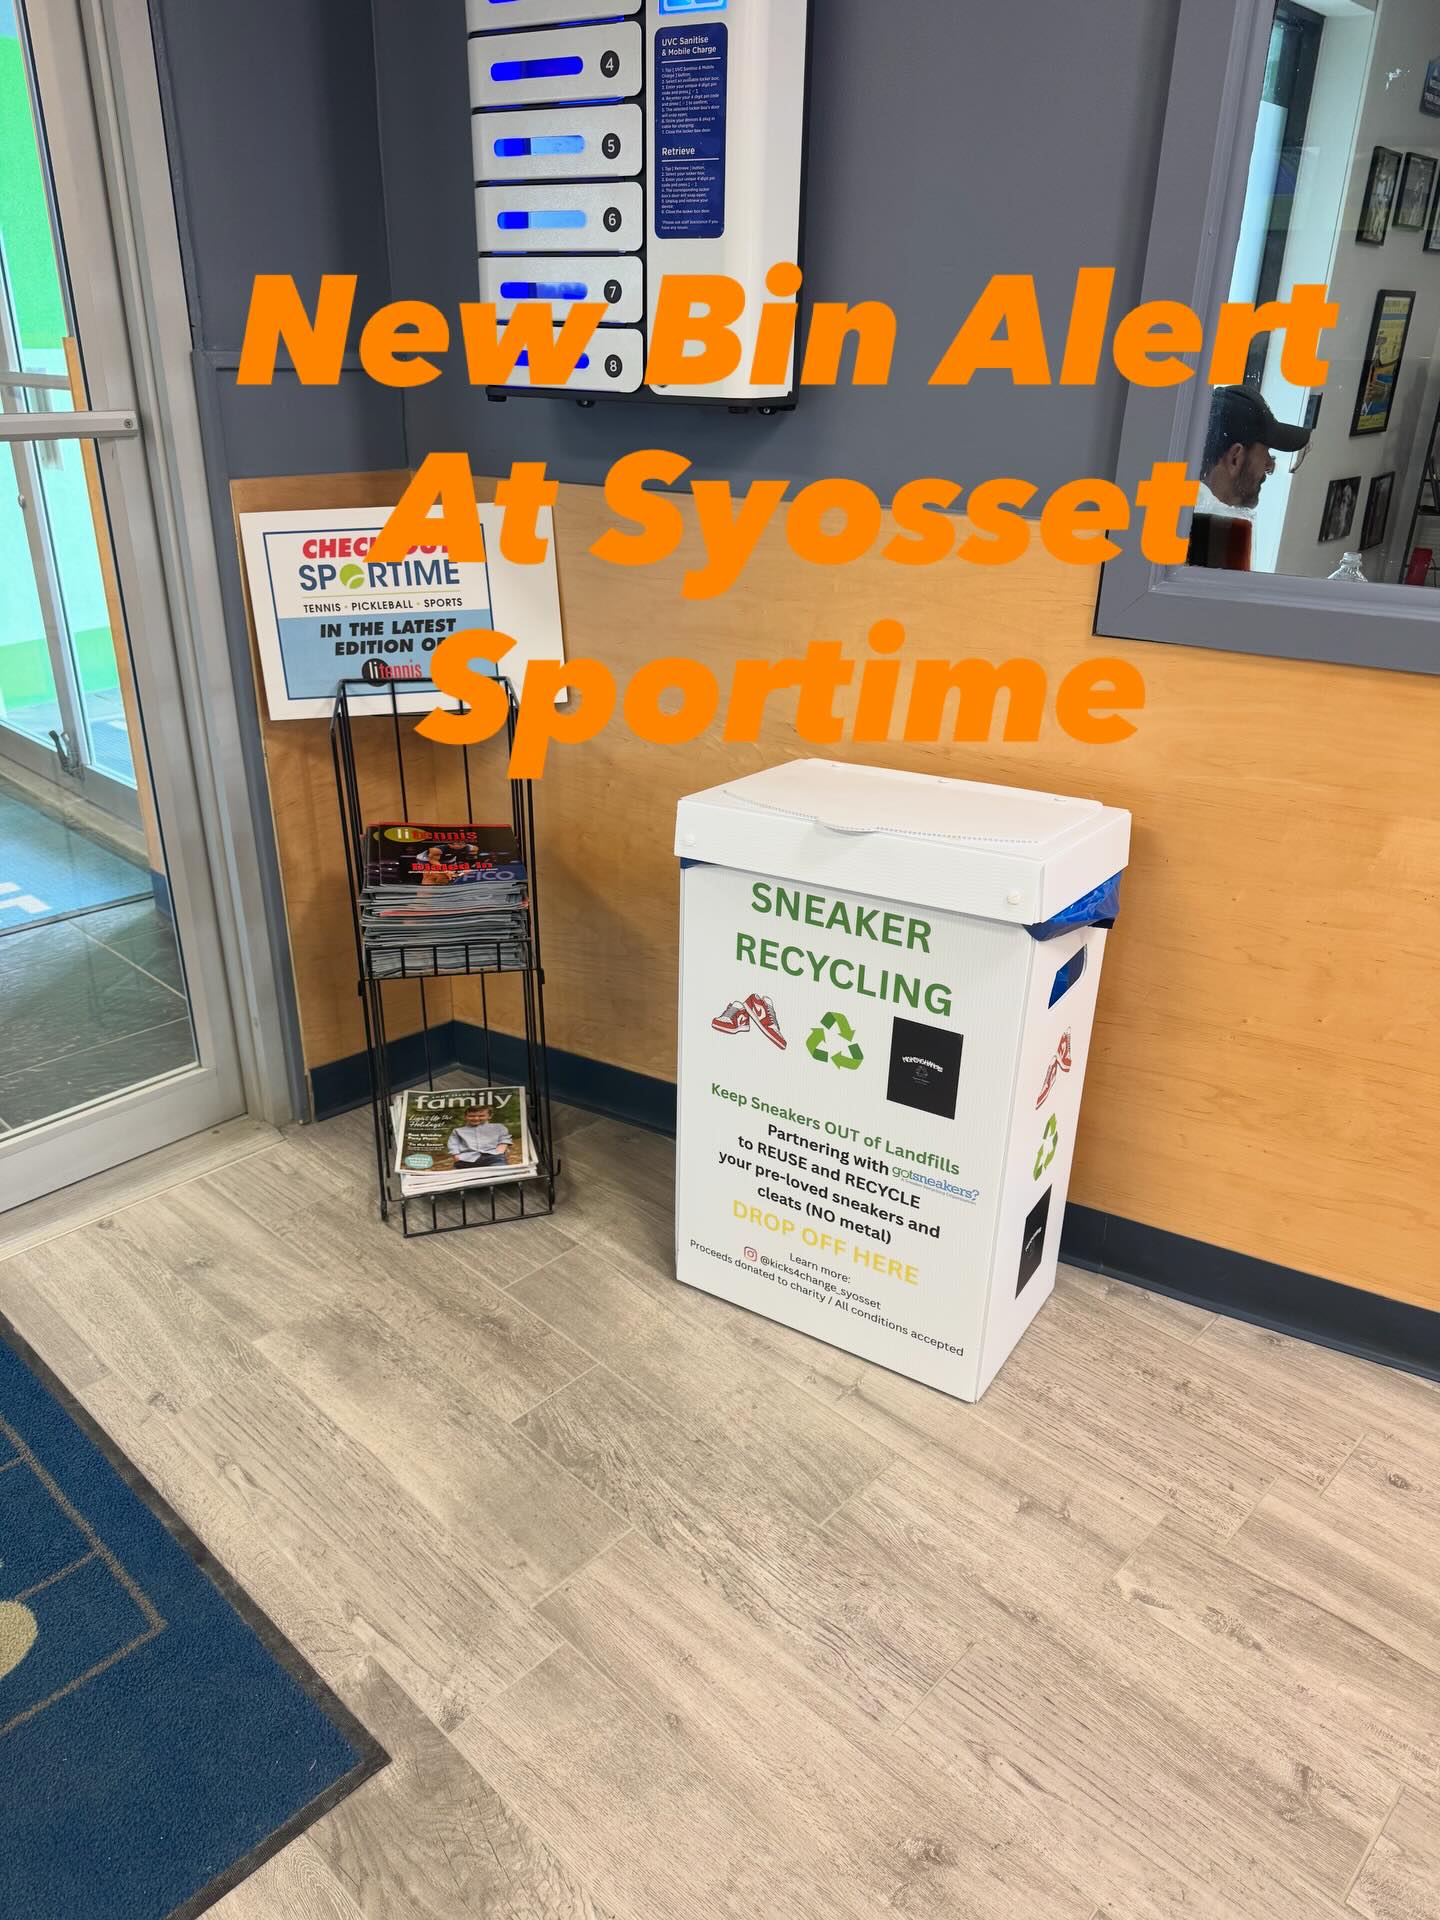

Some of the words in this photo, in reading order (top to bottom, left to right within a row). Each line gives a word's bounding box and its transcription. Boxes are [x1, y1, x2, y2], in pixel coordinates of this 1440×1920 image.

[662, 38, 678, 46] UVC
[680, 36, 709, 45] Sanitise
[668, 48, 691, 56] Mobile
[692, 46, 717, 54] Charge
[606, 57, 615, 72] 4
[607, 139, 616, 153] 5
[662, 147, 696, 156] Retrieve
[608, 213, 617, 227] 6
[609, 286, 617, 299] 7
[609, 360, 618, 372] 8
[302, 537, 380, 559] CHEC
[304, 603, 341, 613] TENNIS
[352, 600, 414, 611] PICKLEBALL
[424, 598, 463, 608] SPORTS
[320, 623, 342, 638] IN
[349, 622, 384, 637] THE
[392, 618, 457, 634] LATEST
[335, 639, 414, 656] EDITION
[751, 882, 933, 954] SNEAKER
[735, 932, 953, 1017] RECYCLING
[415, 1091, 513, 1109] family
[711, 1082, 748, 1107] Keep
[751, 1096, 821, 1131] Sneakers
[824, 1121, 861, 1143] OUT
[864, 1134, 882, 1148] of
[885, 1140, 960, 1176] Landfills
[738, 1135, 753, 1151] to
[757, 1142, 808, 1170] REUSE
[811, 1161, 841, 1182] and
[845, 1173, 921, 1209] RECYCLE
[768, 1124, 850, 1166] Partnering
[854, 1154, 889, 1176] with
[892, 1165, 980, 1201] gotsneakers?
[718, 1152, 752, 1173] your
[755, 1163, 829, 1200] pre-loved
[832, 1192, 904, 1226] sneakers
[908, 1216, 941, 1239] and
[757, 1186, 802, 1212] cleats
[805, 1202, 836, 1224] (NO
[840, 1217, 893, 1245] metal)
[732, 1199, 796, 1236] DROP
[801, 1228, 848, 1256] OFF
[852, 1246, 921, 1286] HERE
[790, 1253, 818, 1272] Learn
[820, 1265, 851, 1284] more:
[760, 1255, 882, 1310] @kicks4change_syosset
[689, 1240, 734, 1265] Proceeds
[734, 1258, 776, 1283] donated
[777, 1274, 789, 1287] to
[790, 1281, 826, 1304] charity
[834, 1299, 849, 1312] All
[851, 1306, 909, 1336] conditions
[910, 1330, 965, 1358] accepted
